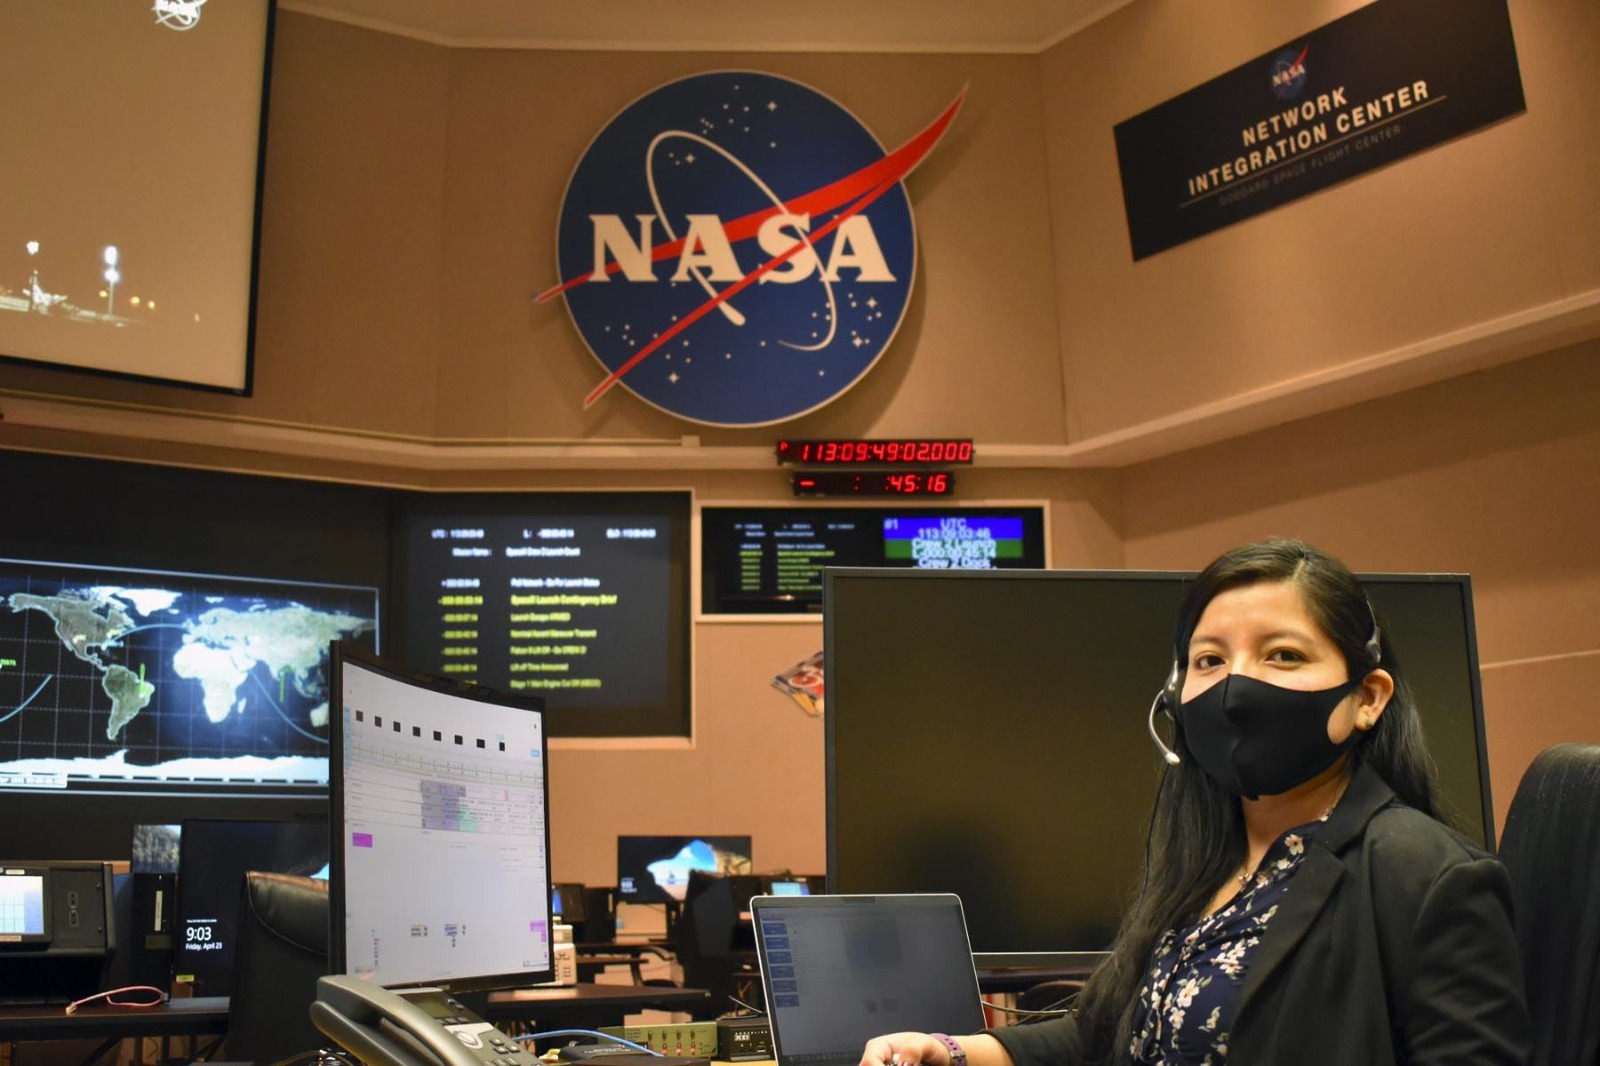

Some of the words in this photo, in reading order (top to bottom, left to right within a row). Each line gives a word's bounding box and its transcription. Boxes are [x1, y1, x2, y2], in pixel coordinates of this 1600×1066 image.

[1272, 64, 1306, 87] NASA
[1242, 86, 1347, 147] NETWORK
[1188, 122, 1328, 195] INTEGRATION
[1336, 80, 1428, 133] CENTER
[1273, 164, 1307, 185] SPACE
[1311, 144, 1351, 168] FLIGHT
[1355, 124, 1402, 151] CENTER
[588, 211, 897, 285] NASA
[940, 518, 967, 530] UTC
[918, 556, 949, 568] Crew
[186, 926, 212, 941] 9:03
[202, 941, 215, 951] April
